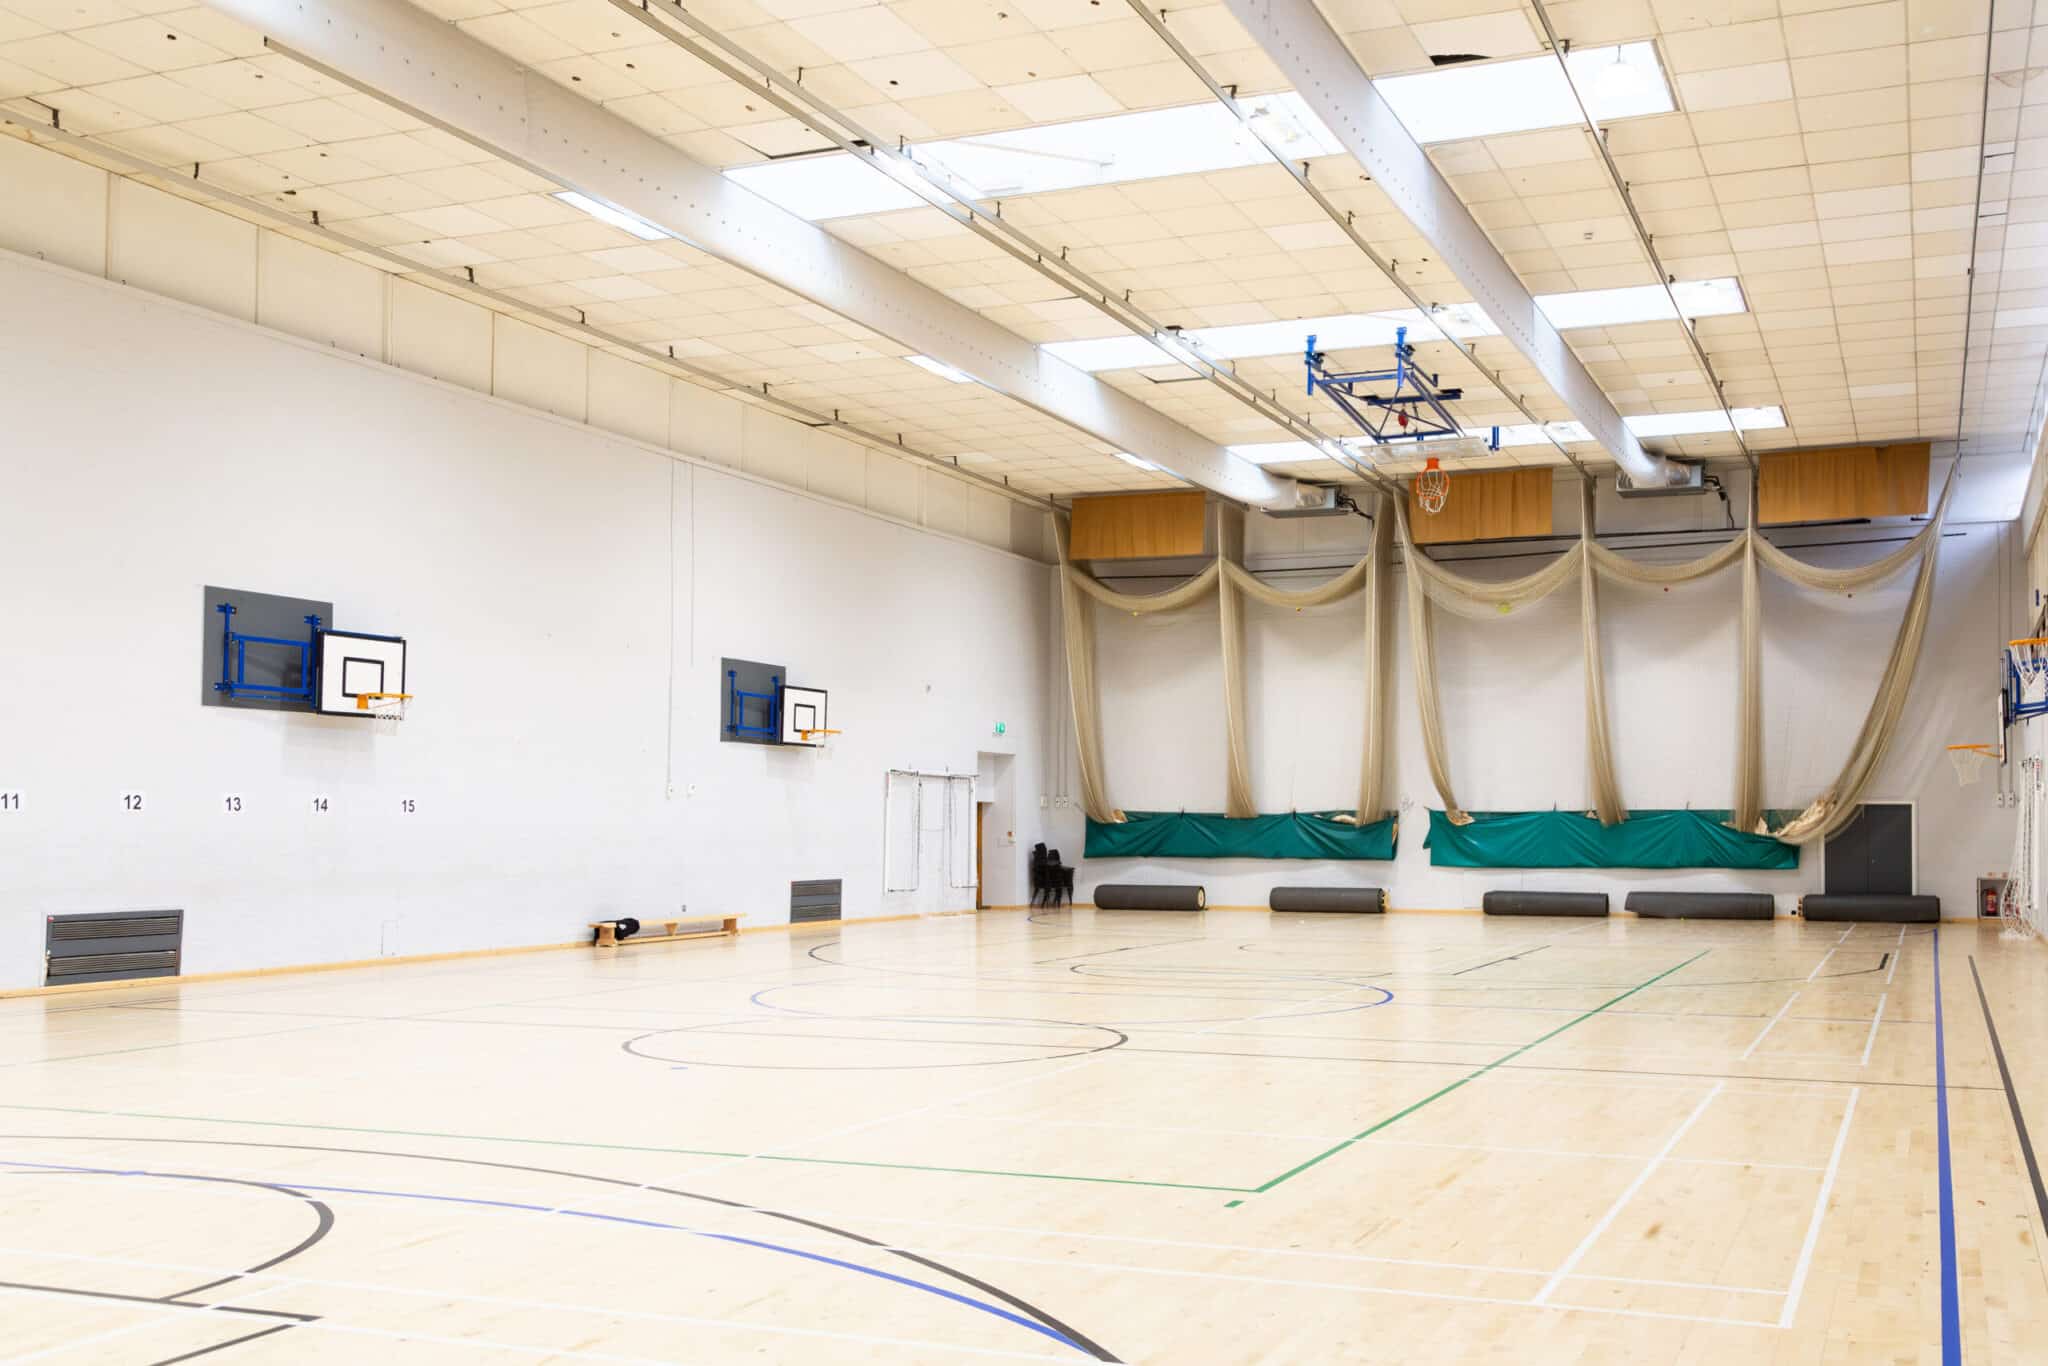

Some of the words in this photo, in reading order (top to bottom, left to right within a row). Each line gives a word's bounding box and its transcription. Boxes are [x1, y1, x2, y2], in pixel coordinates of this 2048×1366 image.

[0, 793, 20, 810] 11
[123, 794, 142, 810] 12
[225, 796, 242, 812] 13
[313, 797, 329, 812] 14
[401, 799, 416, 813] 15
